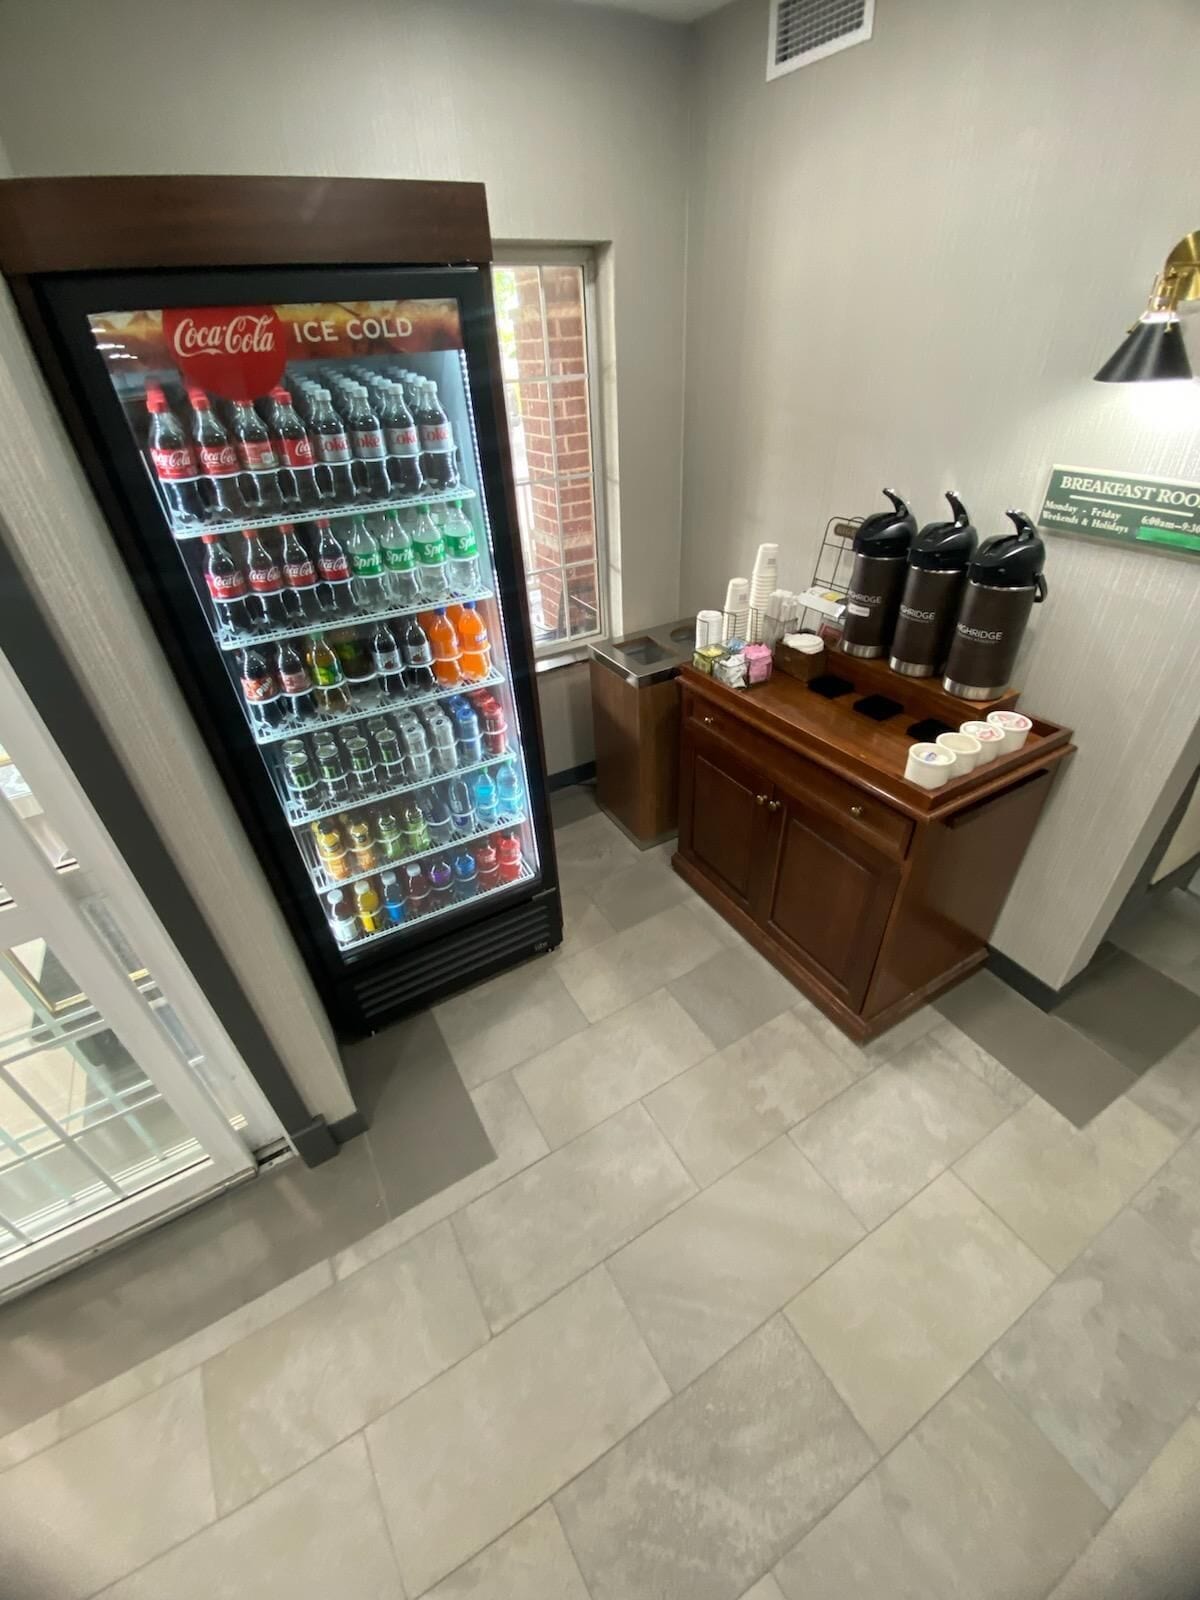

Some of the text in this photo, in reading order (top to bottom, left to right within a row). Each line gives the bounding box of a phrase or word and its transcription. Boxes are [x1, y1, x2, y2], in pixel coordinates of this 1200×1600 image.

[174, 314, 274, 357] Coca-Cola
[293, 317, 413, 343] ICE COLD
[1060, 476, 1200, 508] BREAKFAST ROO
[1044, 500, 1078, 514] Monday
[1091, 507, 1122, 521] Friday
[1091, 518, 1129, 534] Holidays
